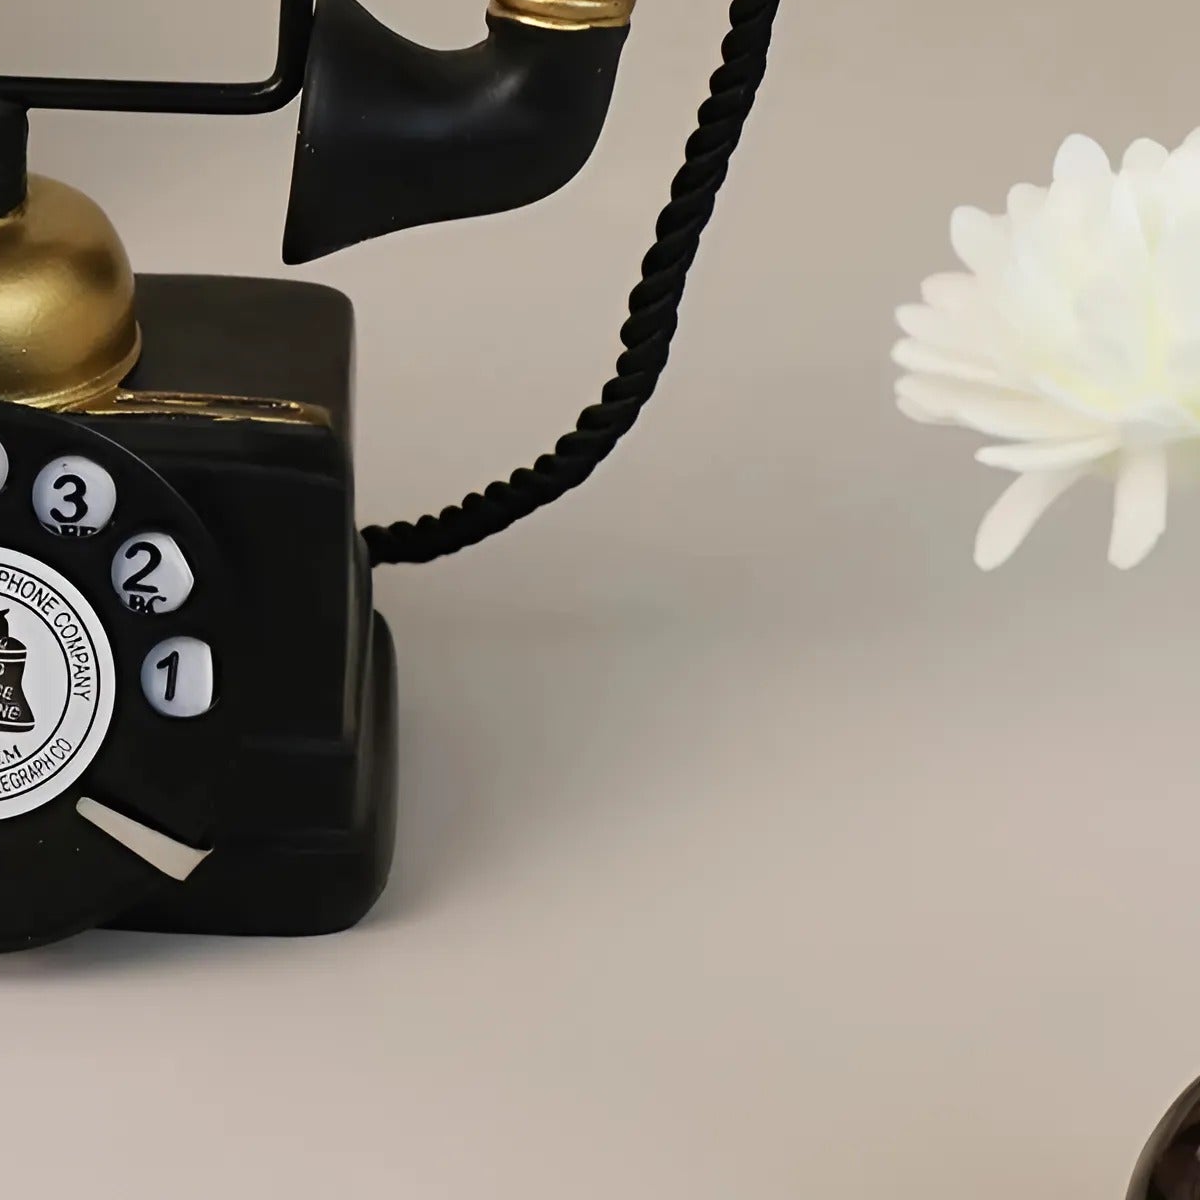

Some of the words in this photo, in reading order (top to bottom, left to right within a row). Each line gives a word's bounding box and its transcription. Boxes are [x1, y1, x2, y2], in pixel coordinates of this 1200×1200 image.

[50, 474, 88, 523] 3
[122, 541, 163, 593] 2
[53, 612, 91, 702] COMPANY
[156, 651, 180, 701] 1
[50, 736, 73, 760] CO
